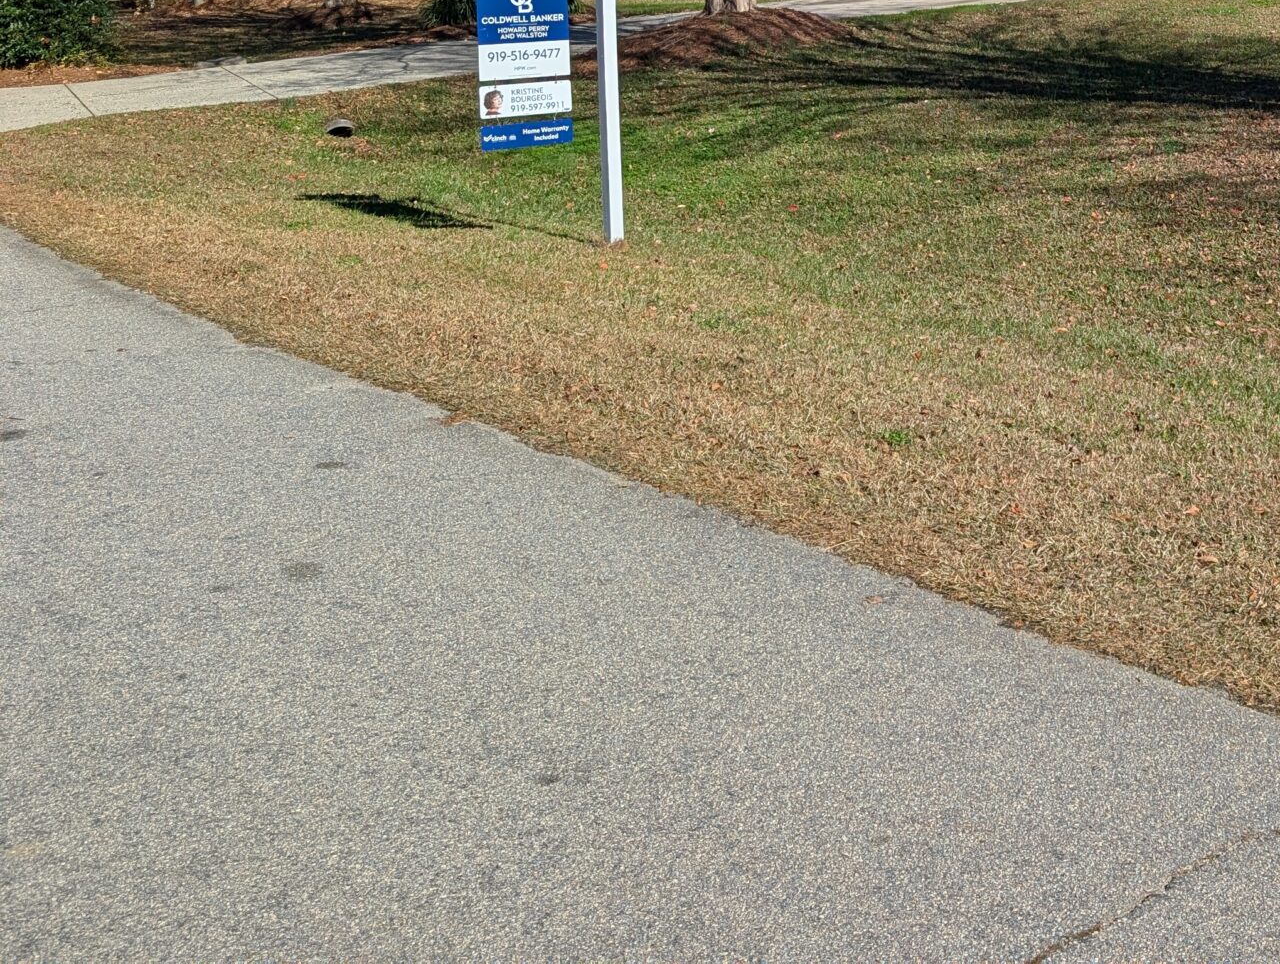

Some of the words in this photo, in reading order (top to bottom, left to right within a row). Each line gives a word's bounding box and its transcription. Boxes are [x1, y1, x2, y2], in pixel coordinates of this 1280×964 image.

[481, 15, 528, 25] COLDWELL
[530, 13, 564, 23] BANKER
[497, 26, 527, 34] HOWARD
[487, 47, 561, 63] 919-516-9477
[510, 87, 544, 95] KRISTINE
[510, 94, 553, 103] BOURGEOIS
[510, 101, 565, 112] 919-597-9911
[540, 124, 570, 133] Warranty
[534, 133, 559, 141] Included
